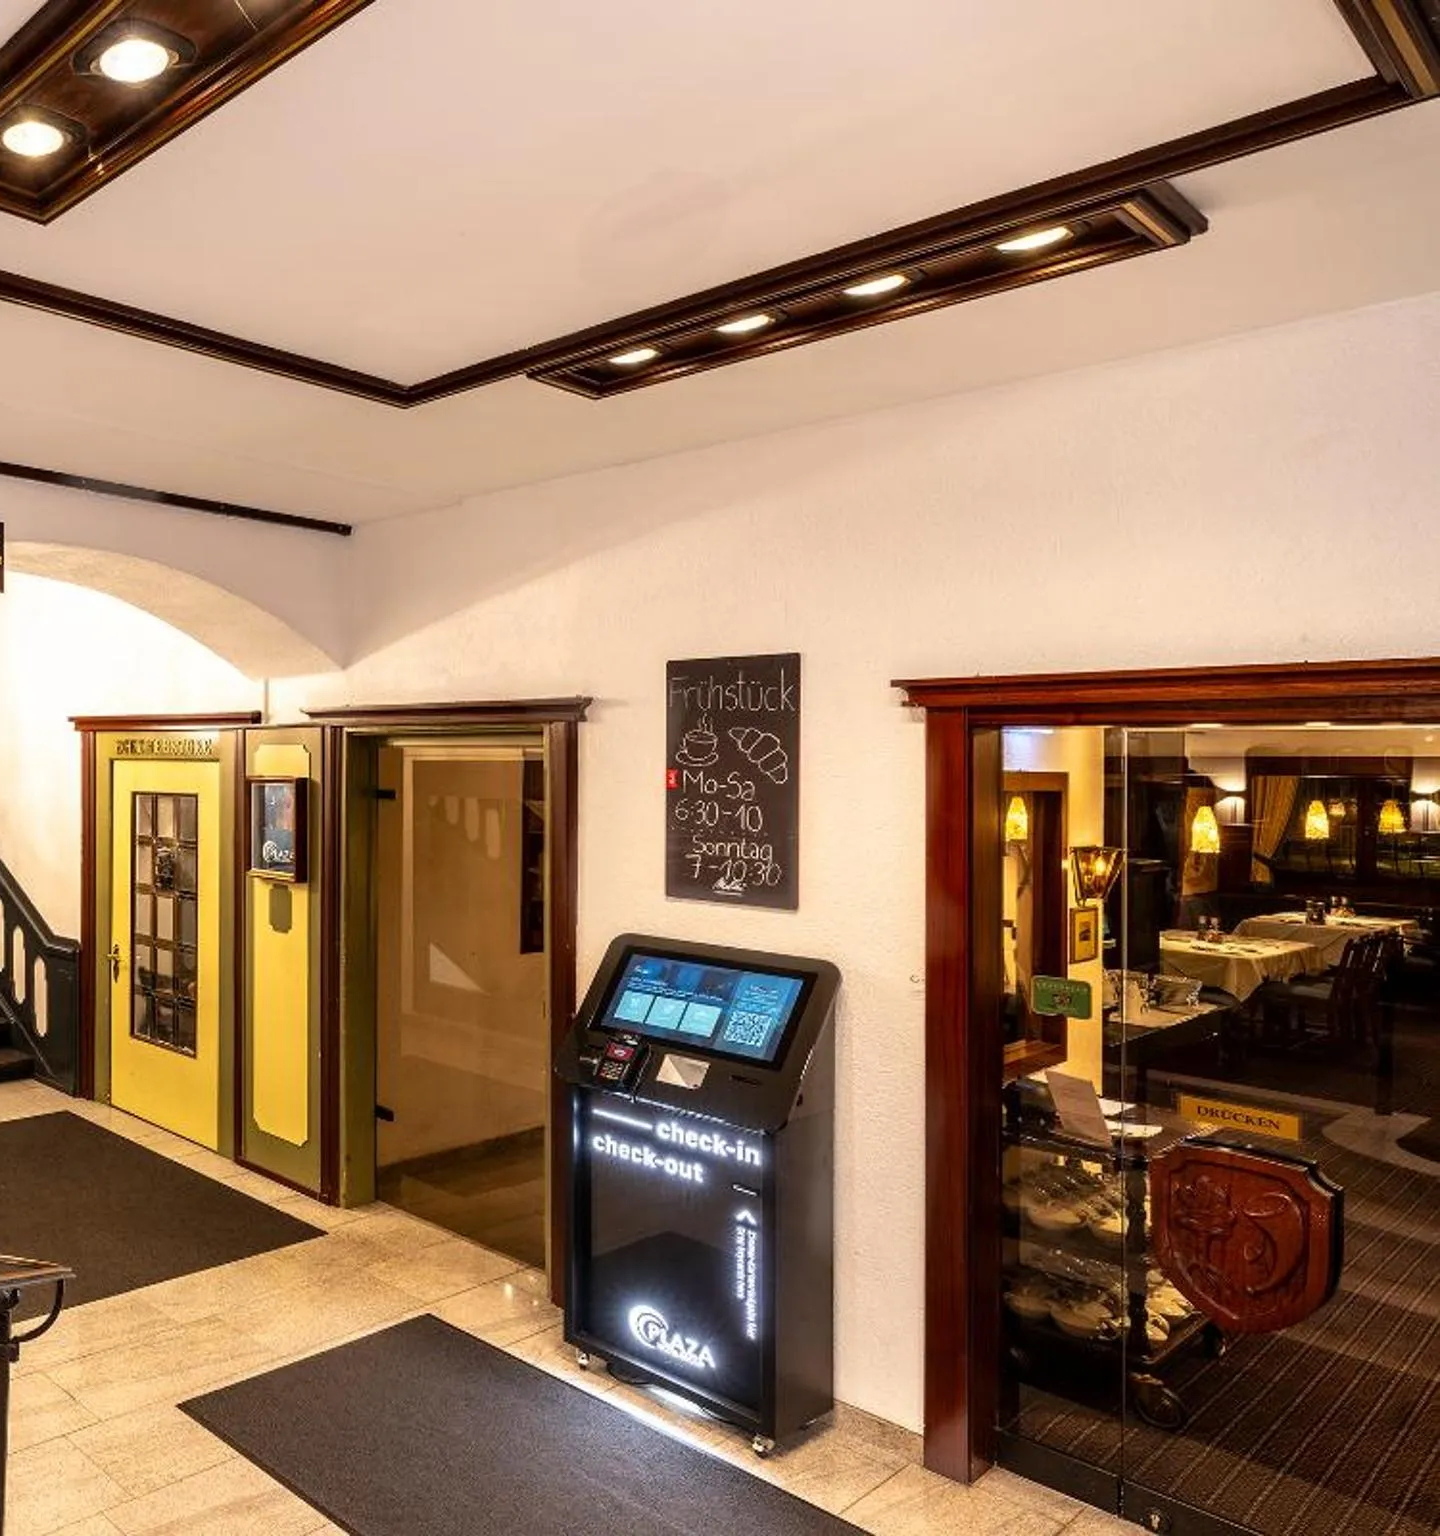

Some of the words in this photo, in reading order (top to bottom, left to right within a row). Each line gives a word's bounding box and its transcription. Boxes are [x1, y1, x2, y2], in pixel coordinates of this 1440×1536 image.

[668, 667, 796, 712] Frühstück
[692, 833, 773, 866] Sonntag
[592, 1133, 704, 1184] check-out
[656, 1121, 761, 1166] check-in
[647, 1322, 716, 1369] PLAZA
